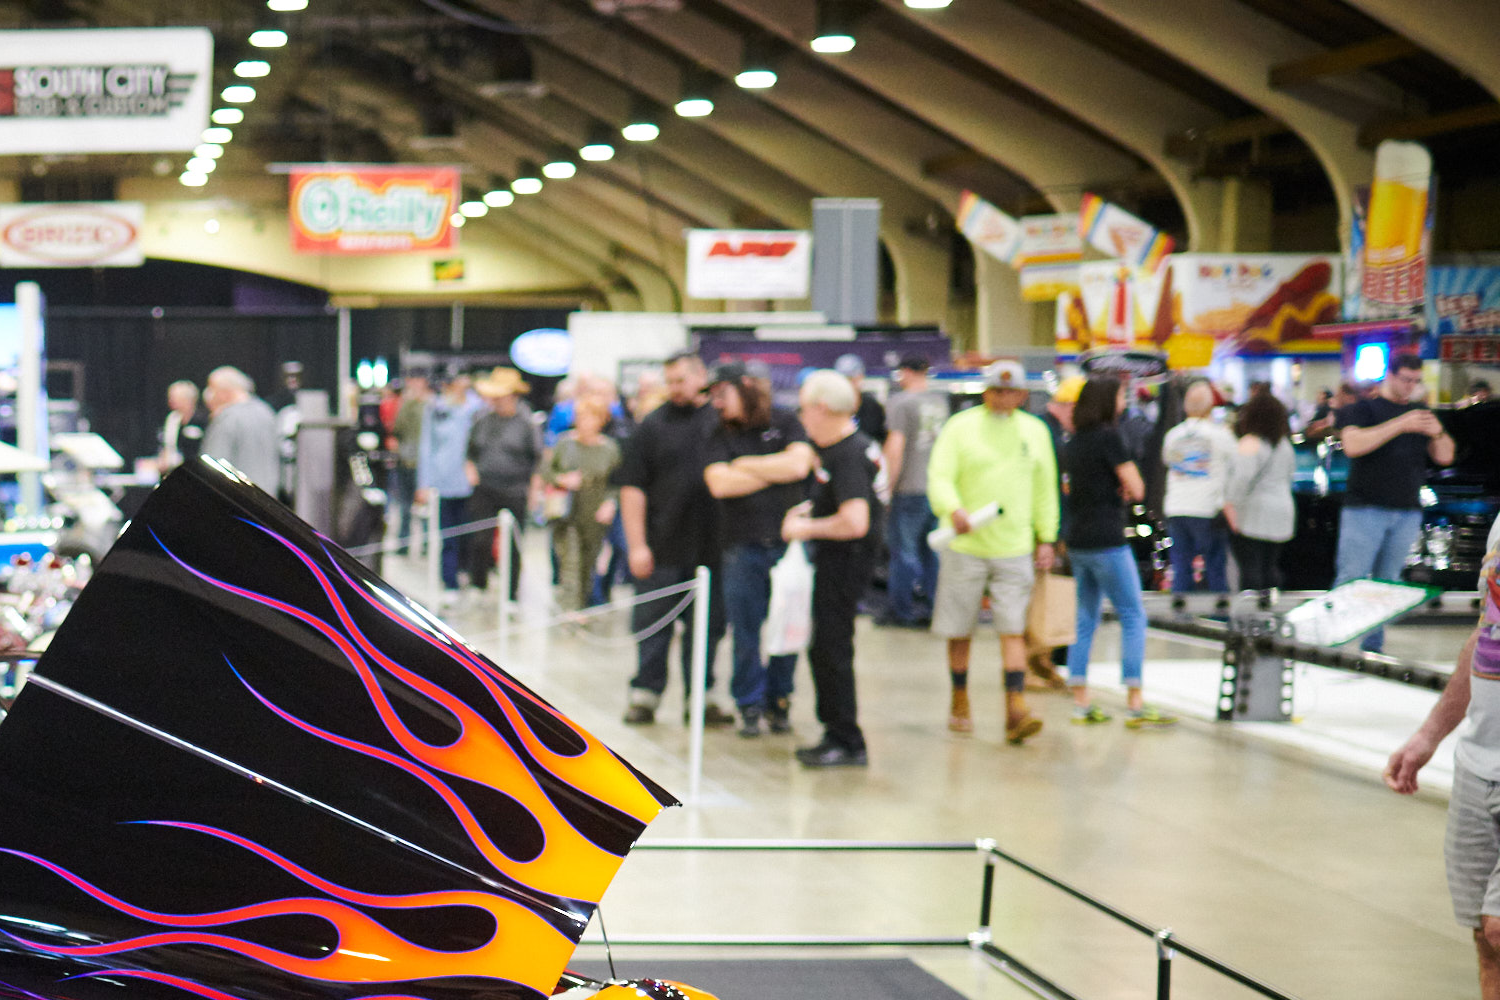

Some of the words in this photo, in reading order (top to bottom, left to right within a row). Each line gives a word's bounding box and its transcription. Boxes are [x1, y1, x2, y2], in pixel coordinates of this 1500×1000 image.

[14, 67, 102, 98] SOUTH
[104, 65, 169, 96] CITY
[299, 177, 447, 239] O'Reilly
[1363, 262, 1424, 302] BEER
